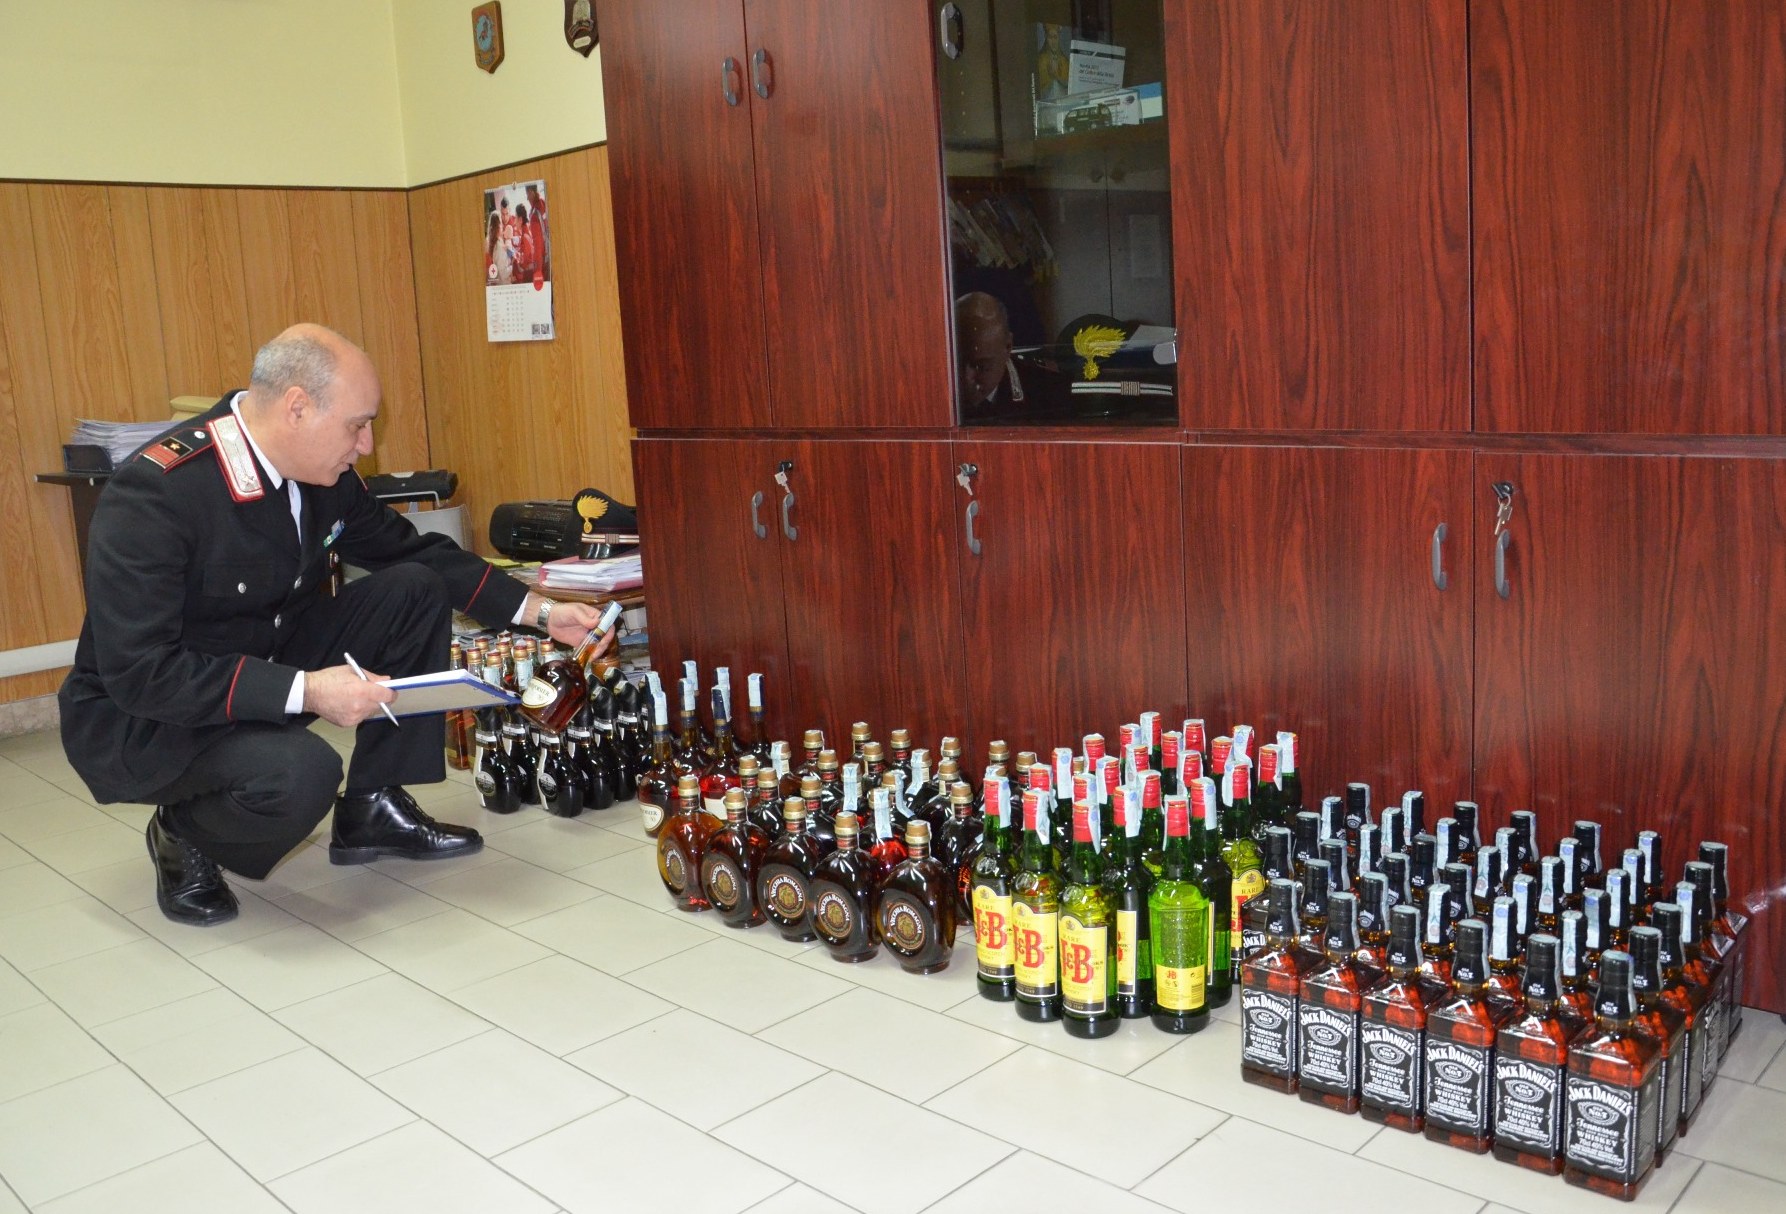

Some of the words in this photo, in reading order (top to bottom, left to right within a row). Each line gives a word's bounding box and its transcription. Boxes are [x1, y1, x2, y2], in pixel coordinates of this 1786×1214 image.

[771, 878, 783, 898] VECCHIA
[783, 876, 803, 902] ROMAGNA
[820, 895, 832, 914] VECCHIA
[832, 894, 850, 921] ROMAGNA
[890, 907, 903, 926] VECCHIA
[903, 905, 922, 933] ROMAGNA
[975, 907, 1007, 949] J&B
[1013, 924, 1045, 968] J&B
[1061, 939, 1094, 984] J&B
[1243, 996, 1260, 1009] JACK
[1260, 994, 1292, 1020] DANIEL'S
[1249, 1024, 1282, 1038] Tennessee
[1301, 1012, 1319, 1026] JACK
[1319, 1010, 1352, 1037] DANIEL'S
[1250, 1034, 1281, 1047] WHISKEY
[1307, 1041, 1342, 1055] Tennessee
[1362, 1029, 1382, 1043] JACK
[1382, 1028, 1416, 1056] DANIEL'S
[1308, 1051, 1341, 1065] WHISKEY
[1369, 1058, 1405, 1075] Tennessee
[1427, 1047, 1448, 1061] JACK
[1448, 1046, 1484, 1074] DANIEL'S
[1370, 1070, 1404, 1084] WHISKEY
[1434, 1077, 1472, 1094] Tennessee
[1497, 1064, 1519, 1079] JACK
[1519, 1063, 1557, 1093] DANIEL'S
[1435, 1089, 1472, 1103] WHISKEY
[1504, 1096, 1544, 1113] Tennessee
[1568, 1086, 1592, 1101] JACK
[1593, 1085, 1633, 1116] DANIEL'S
[1504, 1108, 1543, 1123] WHISKEY
[1576, 1117, 1619, 1136] Tennessee
[1576, 1130, 1617, 1147] WHISKEY
